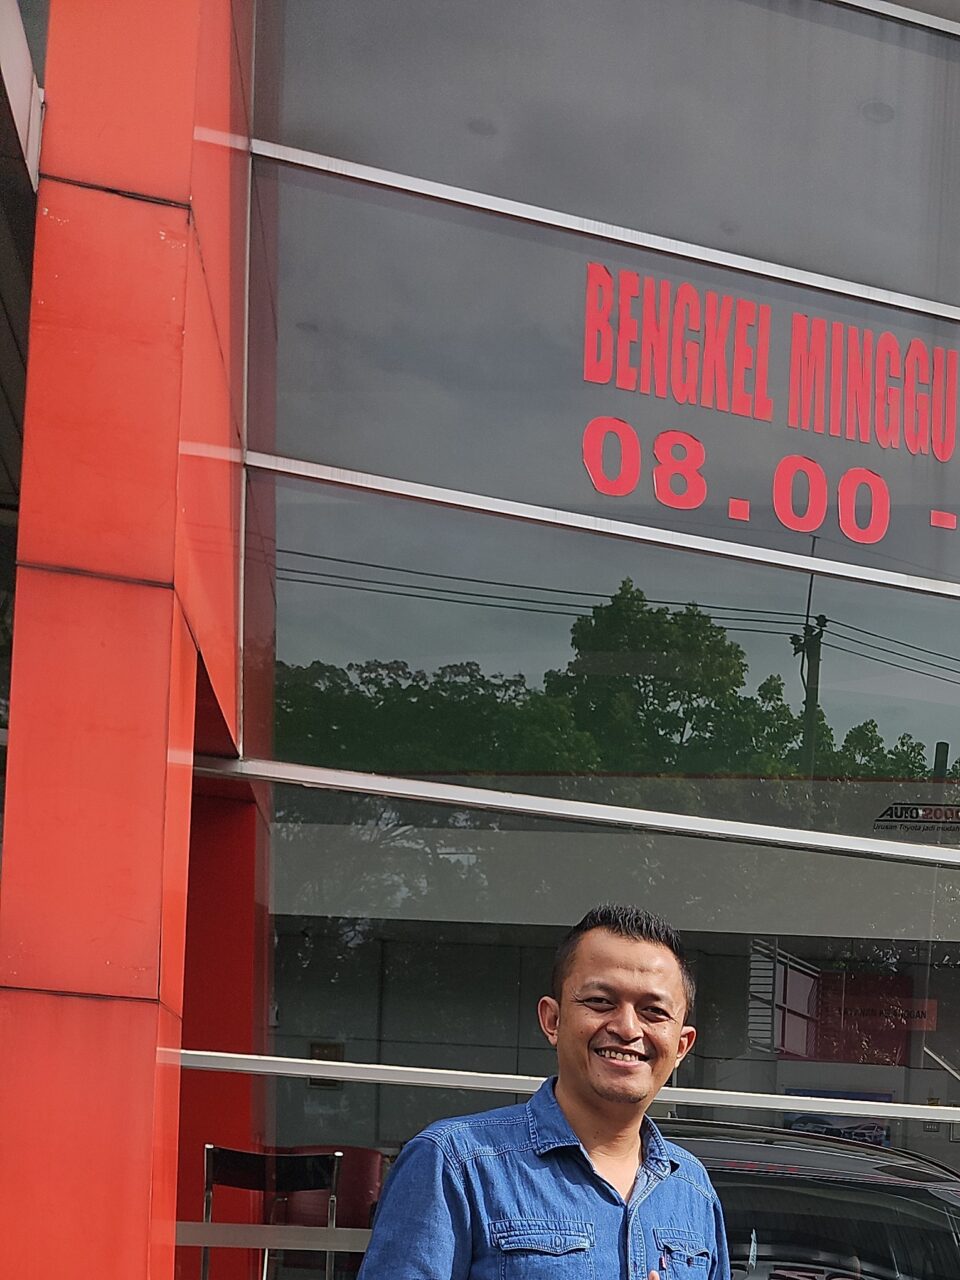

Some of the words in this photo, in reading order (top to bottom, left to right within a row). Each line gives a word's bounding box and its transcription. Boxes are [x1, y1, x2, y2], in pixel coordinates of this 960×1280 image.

[583, 262, 774, 421] BENGKEL
[787, 312, 959, 462] MINGGU
[930, 510, 957, 529] -
[899, 823, 921, 833] Toyota
